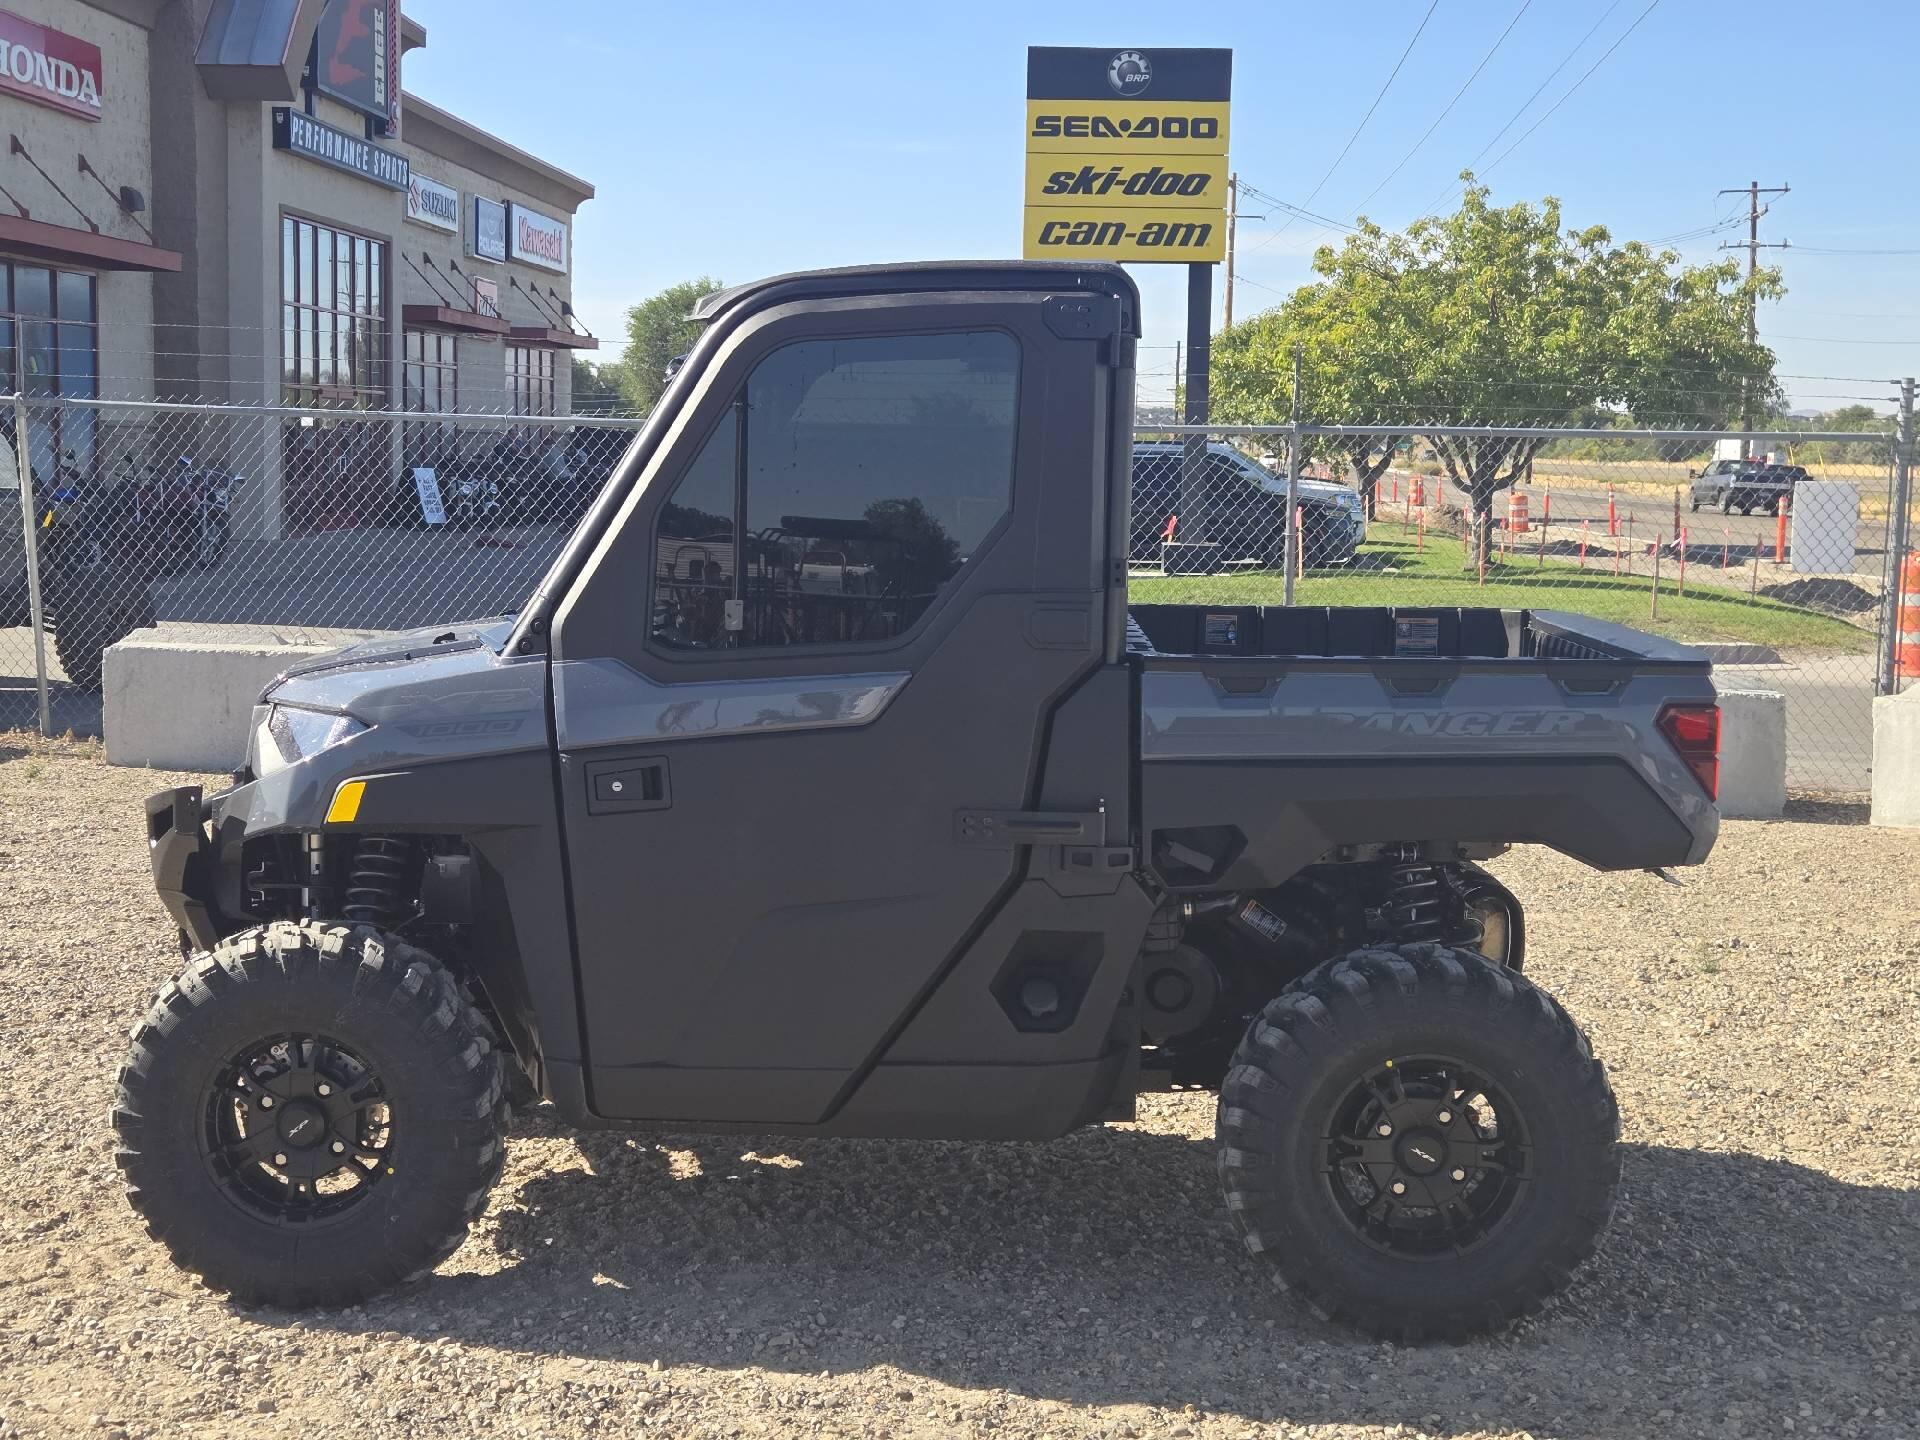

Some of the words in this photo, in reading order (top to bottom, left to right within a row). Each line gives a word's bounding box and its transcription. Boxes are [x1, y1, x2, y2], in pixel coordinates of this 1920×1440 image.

[374, 7, 385, 106] EDGE
[1125, 74, 1150, 83] BRP
[291, 115, 369, 171] PERFORMANCE
[373, 150, 408, 186] SPORTS
[1042, 166, 1212, 196] ski-doo
[420, 189, 457, 224] SUZUKI
[518, 215, 563, 264] Kawasaki
[1038, 222, 1213, 247] can-am
